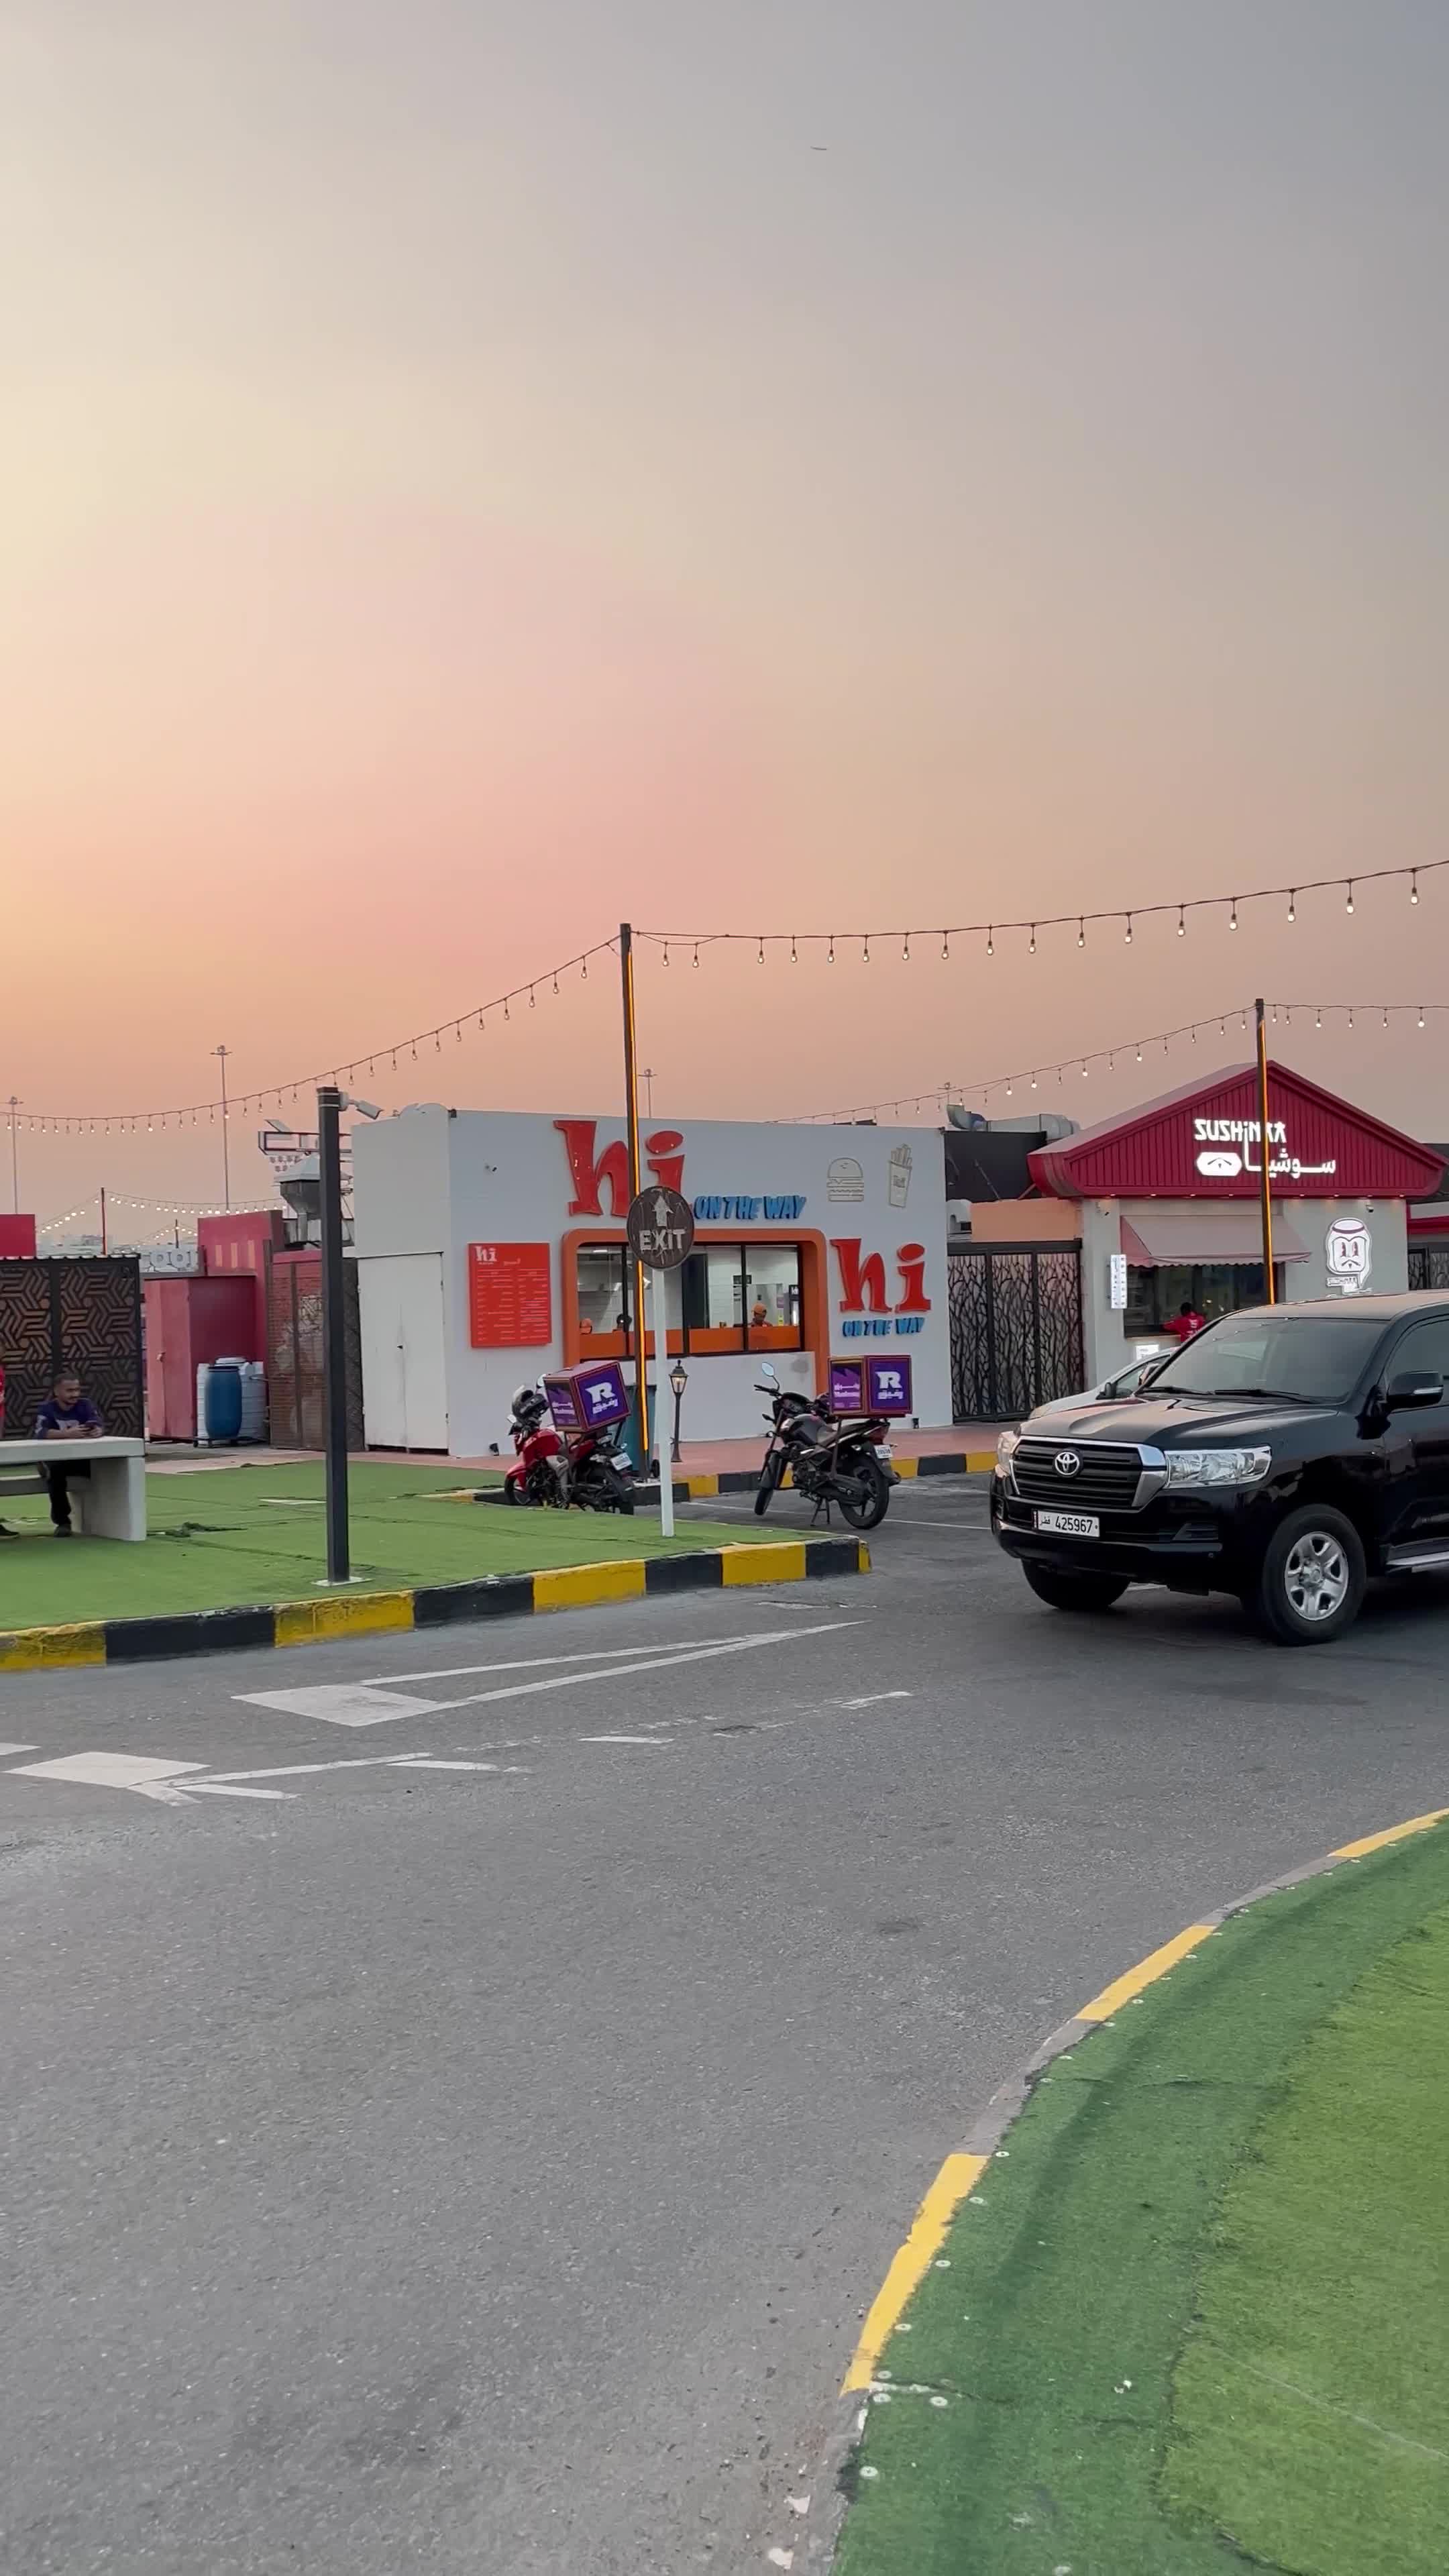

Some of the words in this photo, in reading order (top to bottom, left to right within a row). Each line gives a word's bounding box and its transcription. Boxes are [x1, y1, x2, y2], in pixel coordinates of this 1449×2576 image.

[553, 1120, 692, 1218] hi
[694, 1195, 721, 1220] ON
[722, 1195, 763, 1220] THE
[763, 1195, 806, 1220] WAY
[639, 1229, 686, 1251] EXIT
[475, 1246, 497, 1262] hi
[829, 1238, 931, 1313] hi
[875, 1371, 902, 1389] R
[585, 1382, 616, 1403] R
[1055, 1516, 1093, 1534] 425967
